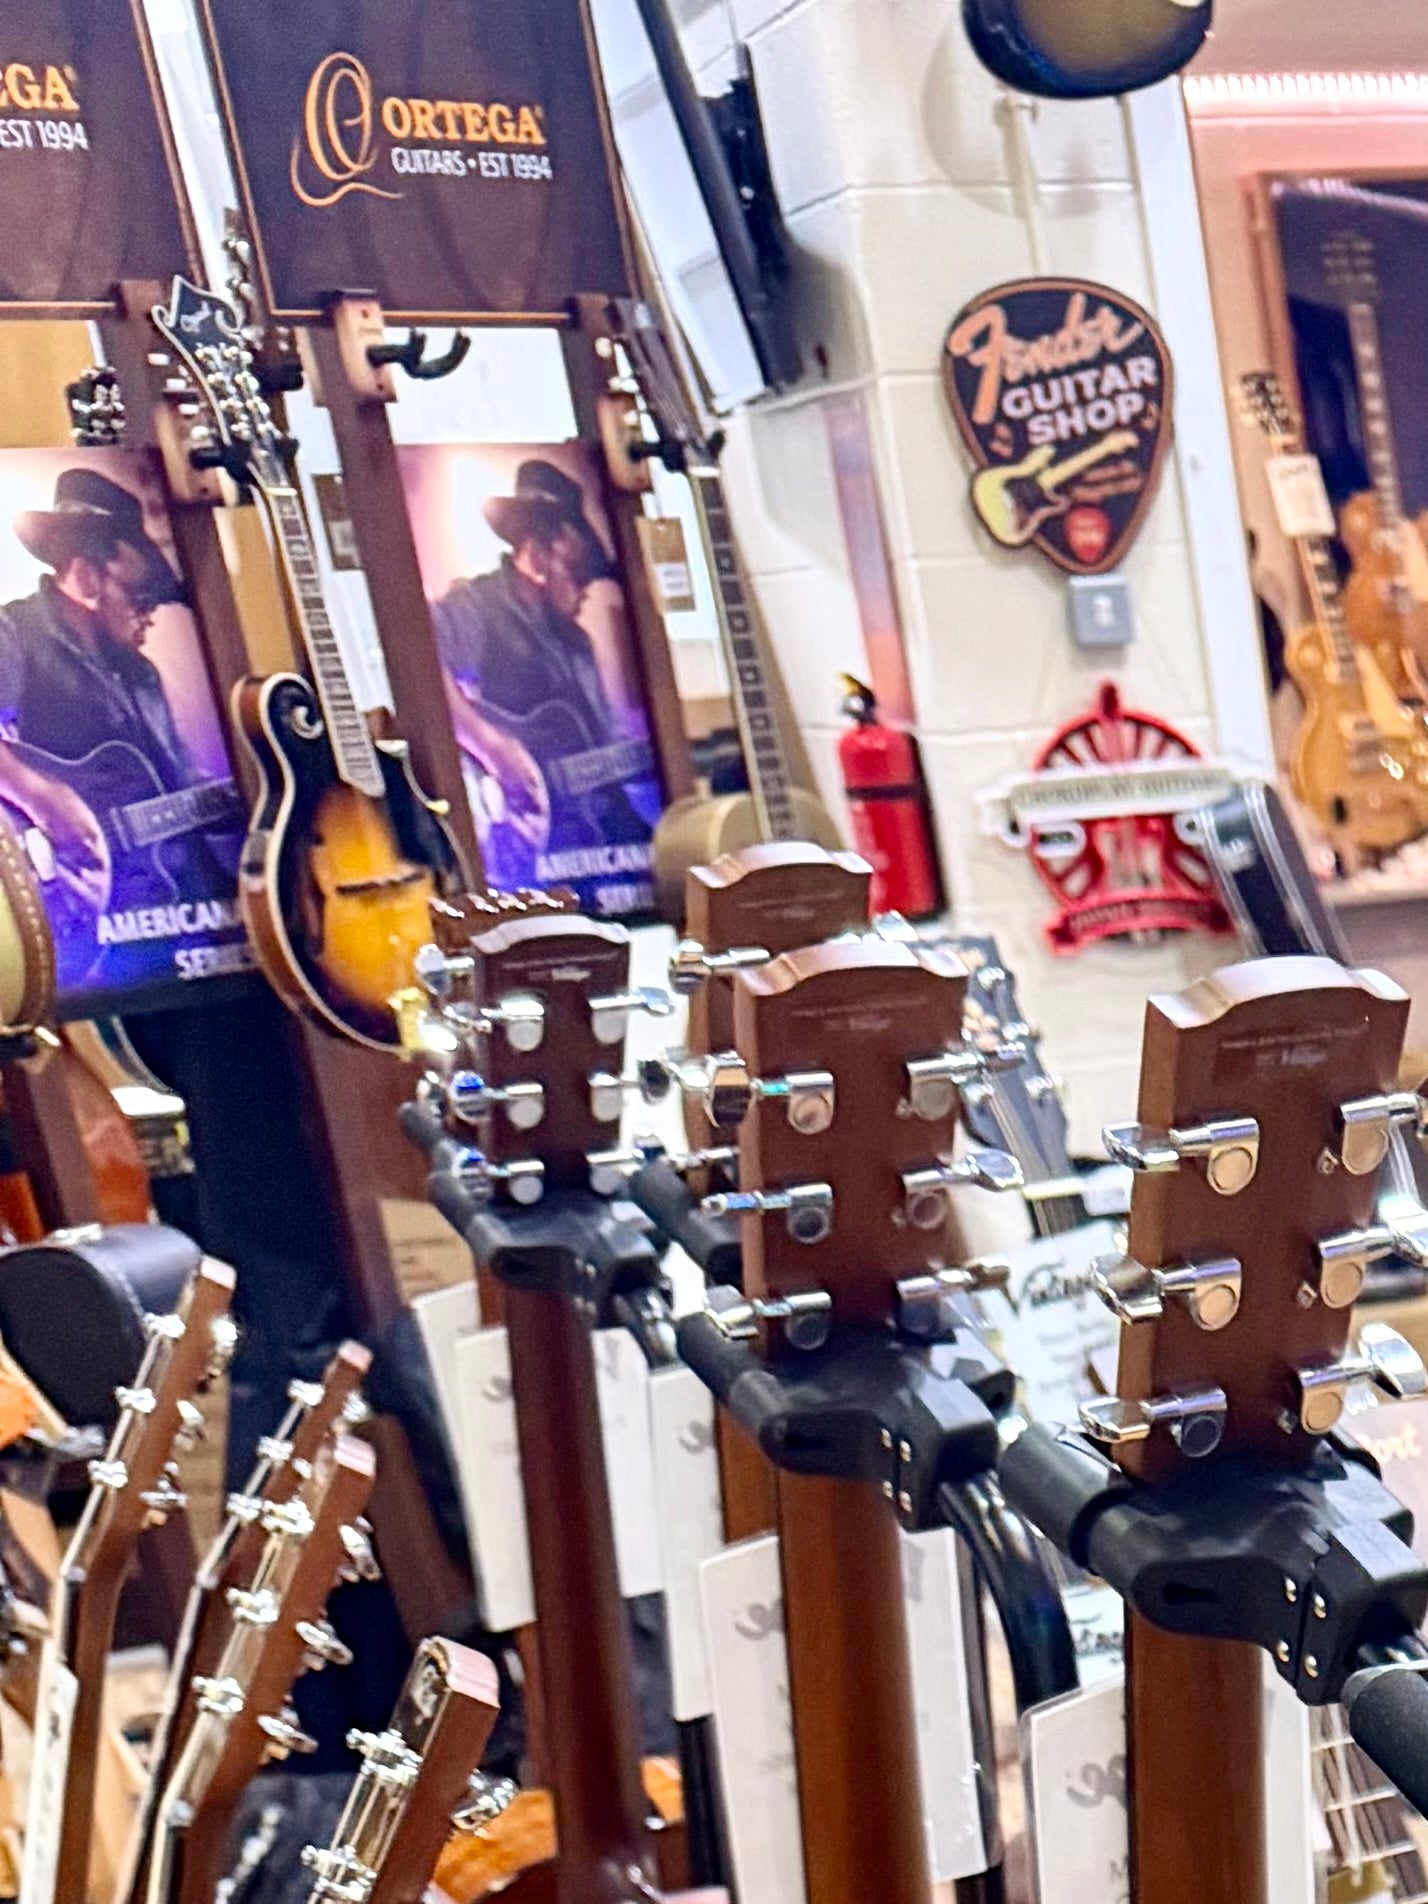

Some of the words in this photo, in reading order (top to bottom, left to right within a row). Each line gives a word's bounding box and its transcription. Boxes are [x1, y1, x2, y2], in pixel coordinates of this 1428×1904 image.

[38, 121, 89, 151] 1994
[382, 96, 546, 145] ORTEGA
[390, 147, 466, 176] GUITARS
[477, 151, 509, 178] EST
[511, 154, 552, 180] 1994
[946, 291, 1147, 425] Fender
[1001, 356, 1159, 419] GUITAR
[1027, 392, 1145, 446] SHOP
